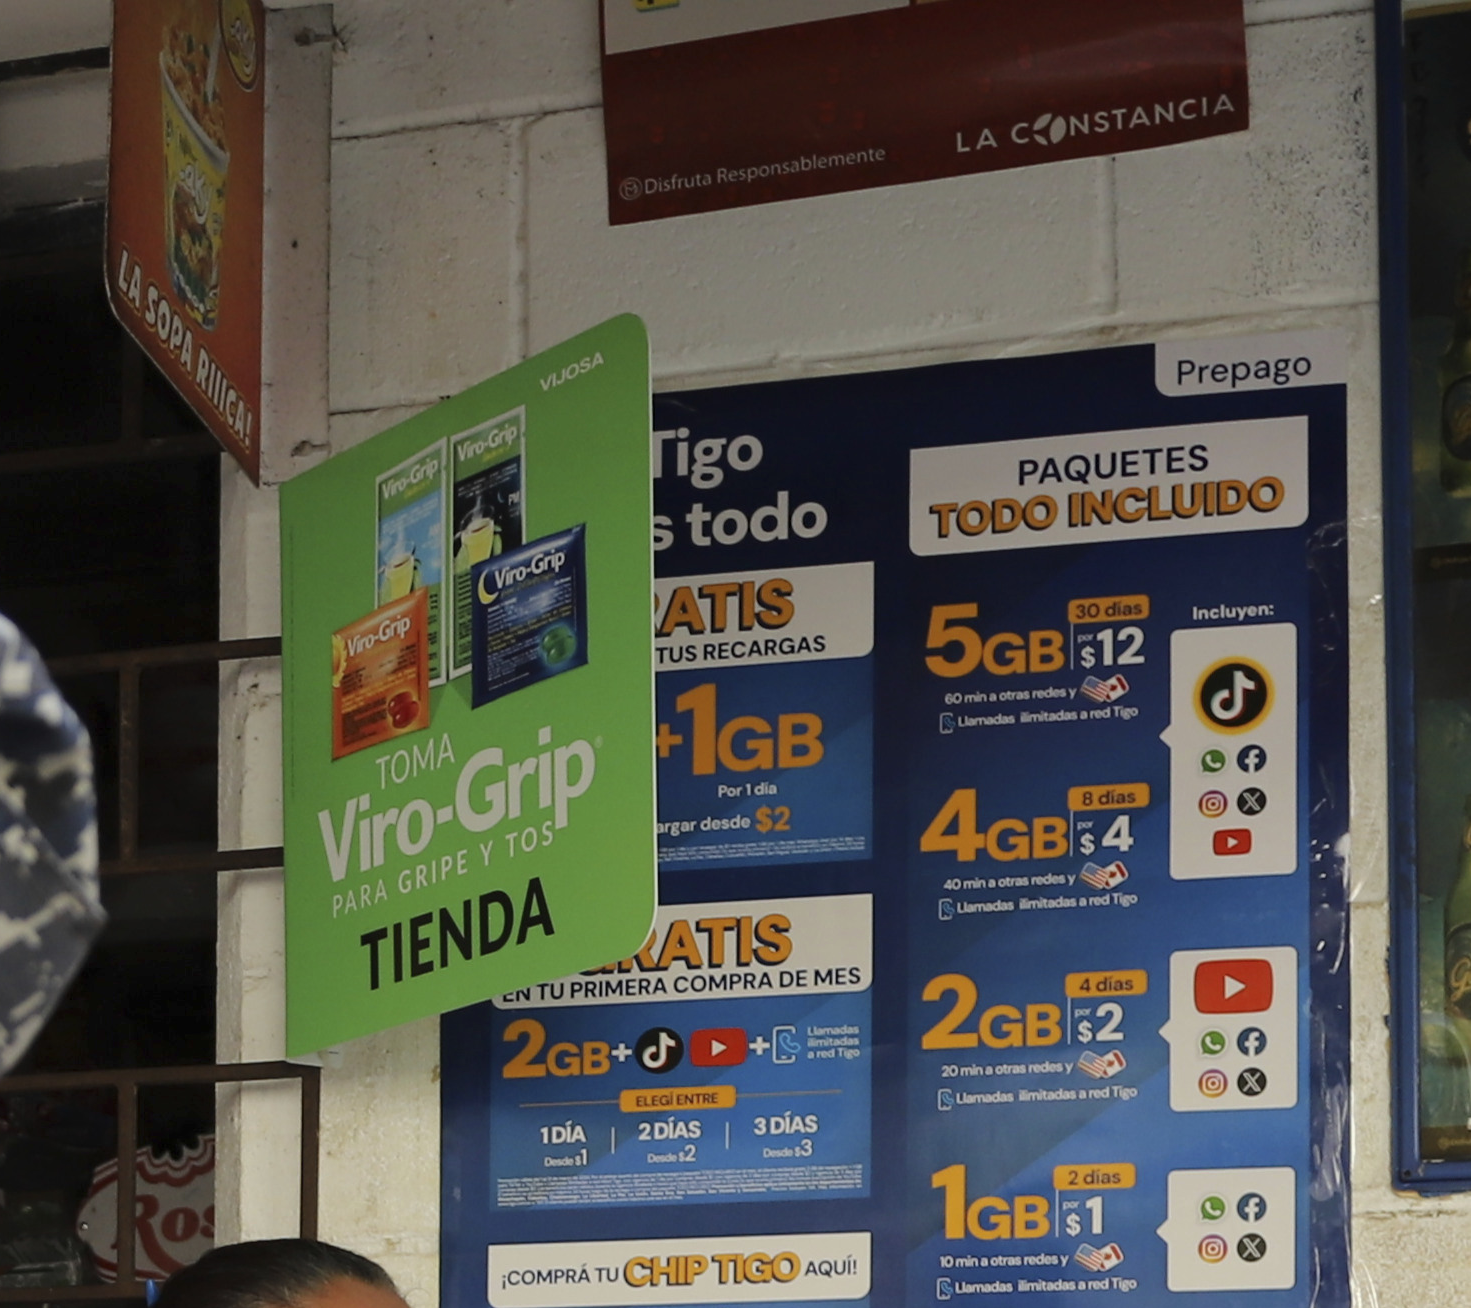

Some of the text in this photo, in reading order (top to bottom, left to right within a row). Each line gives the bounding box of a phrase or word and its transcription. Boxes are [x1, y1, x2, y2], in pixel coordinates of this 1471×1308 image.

[957, 127, 998, 153] LA
[644, 146, 886, 194] Disfruta Responsablemente
[118, 249, 252, 447] LA SOPA RIIICA!
[539, 352, 604, 392] VIJOSA
[1176, 356, 1312, 388] Prepago
[458, 422, 518, 461] Viro-Grip
[653, 427, 763, 489] Tigo
[382, 457, 439, 500] Viro-Grip
[1018, 445, 1209, 486] PAQUETES
[686, 491, 828, 546] todo
[930, 476, 1285, 538] TODO INCLUIDO
[494, 549, 565, 589] Viro-Grip
[655, 578, 795, 638] ATIS
[1075, 601, 1143, 620] 30 días
[1192, 604, 1275, 621] Incluyen:
[347, 615, 411, 657] Viro-Grip
[657, 635, 826, 664] TUS RECARGAS
[925, 602, 1066, 678] 5GB
[1077, 633, 1094, 644] por
[1081, 626, 1145, 669] $12
[375, 733, 455, 790] TOMA
[318, 725, 596, 883] Viro-Grip
[718, 782, 777, 798] Por 1 día
[1082, 789, 1136, 806] 8 días
[656, 805, 791, 837] argar desde $2
[920, 788, 1069, 862] 4GB
[1077, 820, 1094, 831] por
[332, 820, 553, 918] PARA GRIPE Y TOS
[360, 876, 555, 990] TIENDA
[503, 967, 861, 1003] EN TU PRIMERA COMPRA DE MES
[1079, 976, 1134, 992] 4 días
[921, 973, 1062, 1050] 2GB
[1075, 1007, 1091, 1018] por
[636, 1090, 718, 1107] ELEGÍ ENTRE
[638, 1117, 701, 1140] 2 DÍAS
[753, 1111, 818, 1135] 3 DÍAS
[544, 1149, 587, 1167] Desde $1
[647, 1146, 696, 1163] Desde $2
[763, 1140, 813, 1158] Desde $3
[1068, 1168, 1121, 1186] 2 días
[931, 1164, 1050, 1240] 1GB
[1063, 1200, 1079, 1211] por
[502, 1251, 857, 1289] ¡COMPRÁ TU CHIP TIGO AQUÍ!
[940, 1252, 1069, 1267] 10 min a otras redes y
[955, 1277, 1137, 1294] Llamadas ilimitadas a red Tigo
